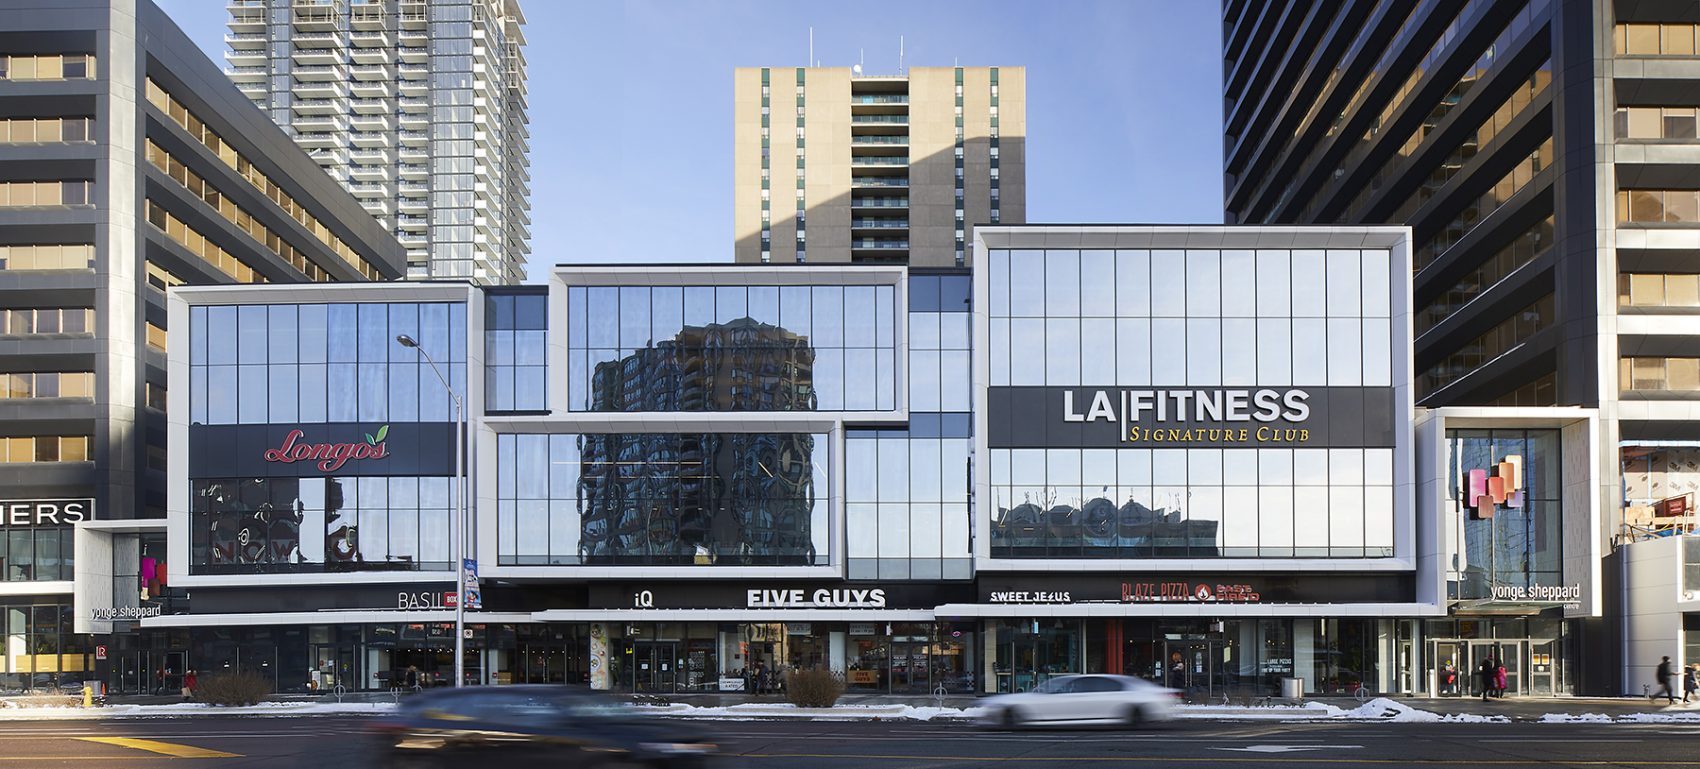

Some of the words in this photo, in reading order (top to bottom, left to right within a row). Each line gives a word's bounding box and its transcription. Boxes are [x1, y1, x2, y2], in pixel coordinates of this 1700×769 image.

[1064, 390, 1117, 422] LA
[1130, 389, 1310, 422] FITNESS
[1130, 426, 1248, 442] SIGNATURE
[1256, 426, 1309, 442] CLUB
[0, 503, 84, 525] ERS
[634, 590, 653, 607] iQ
[747, 589, 804, 607] FIVE
[813, 589, 886, 607] GUYS
[990, 592, 1029, 601] SWEET
[1122, 583, 1155, 601] BLAZE
[1161, 583, 1189, 601] PIZZA
[1491, 586, 1525, 600] yonge
[1528, 583, 1580, 600] sheppard
[398, 592, 441, 610] BASIL
[90, 608, 117, 620] yonge
[120, 605, 161, 619] sheppard
